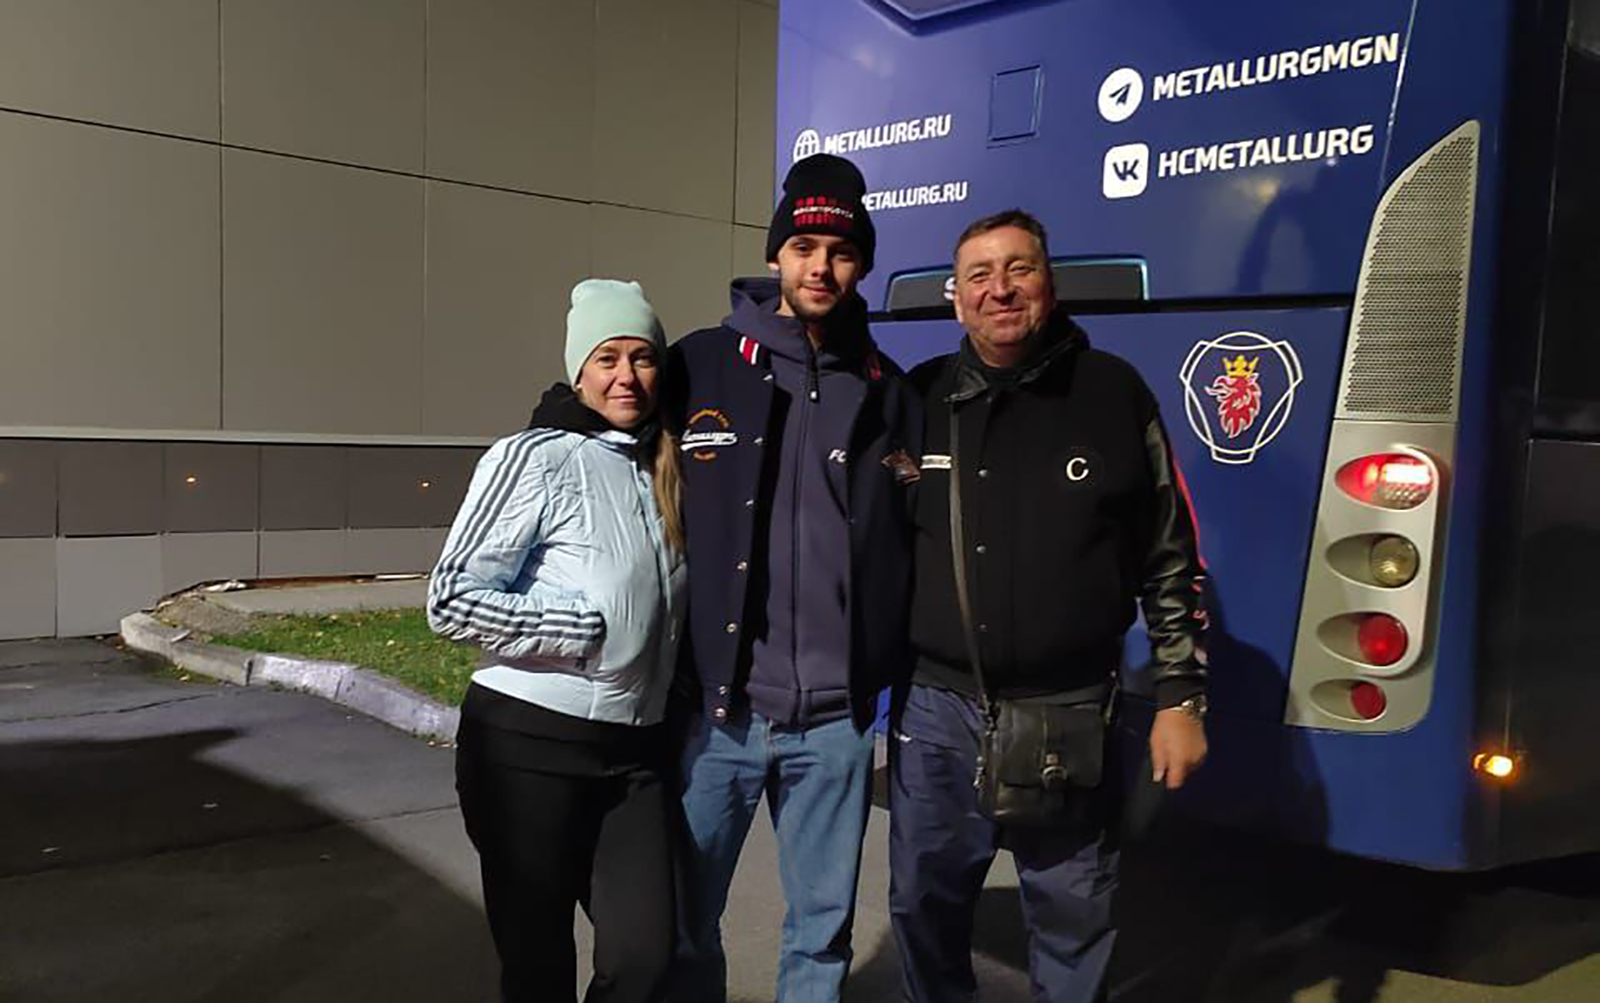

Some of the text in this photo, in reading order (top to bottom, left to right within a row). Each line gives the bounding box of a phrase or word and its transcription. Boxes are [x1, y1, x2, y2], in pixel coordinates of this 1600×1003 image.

[1152, 33, 1398, 101] METALLURGMGN
[823, 114, 951, 155] METALLURG.RU
[1157, 125, 1373, 178] HCMETALLURG
[861, 181, 968, 211] ETALLURG.RU
